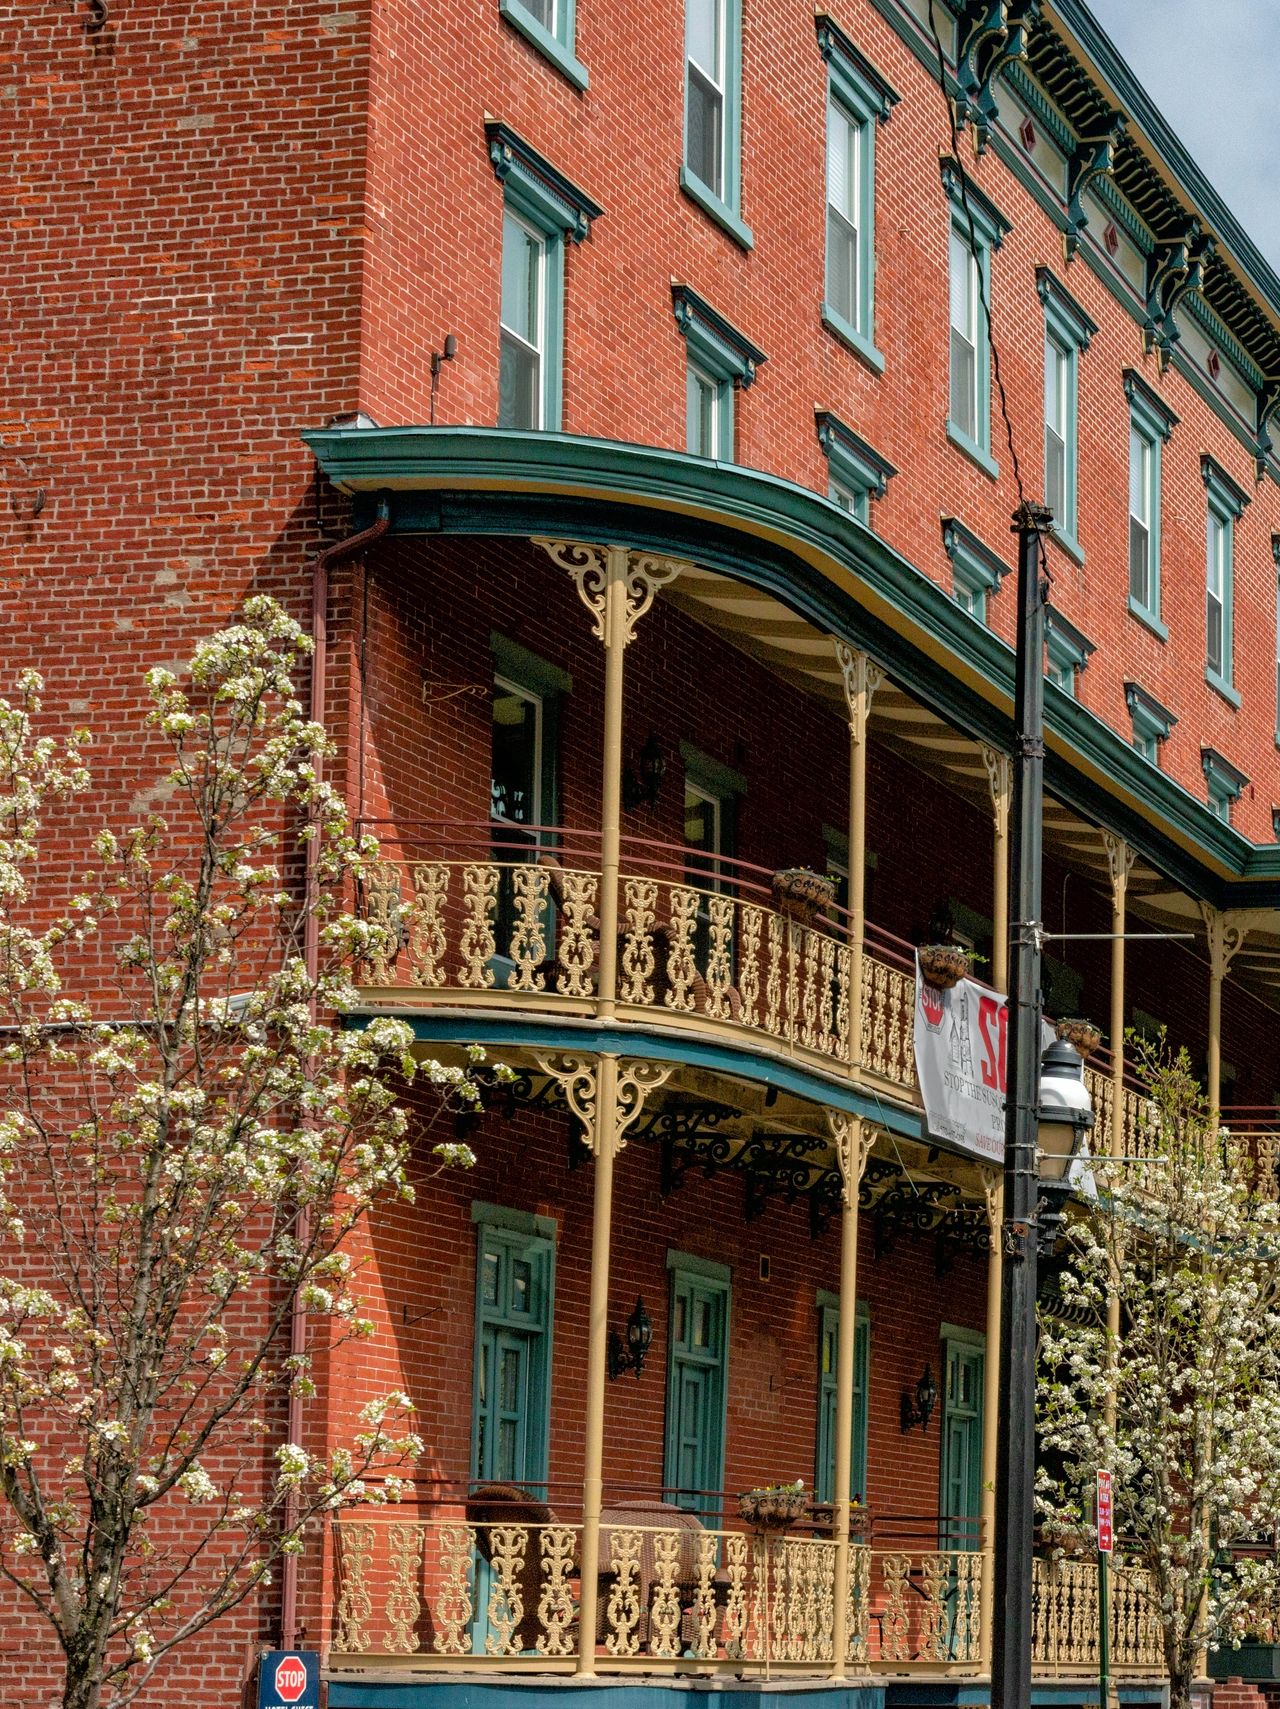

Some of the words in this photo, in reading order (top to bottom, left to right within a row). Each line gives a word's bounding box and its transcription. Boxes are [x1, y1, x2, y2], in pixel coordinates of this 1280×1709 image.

[944, 1070, 964, 1093] STOP
[964, 1080, 982, 1101] THE
[975, 1132, 992, 1152] SAVE
[277, 1670, 305, 1688] STOP
